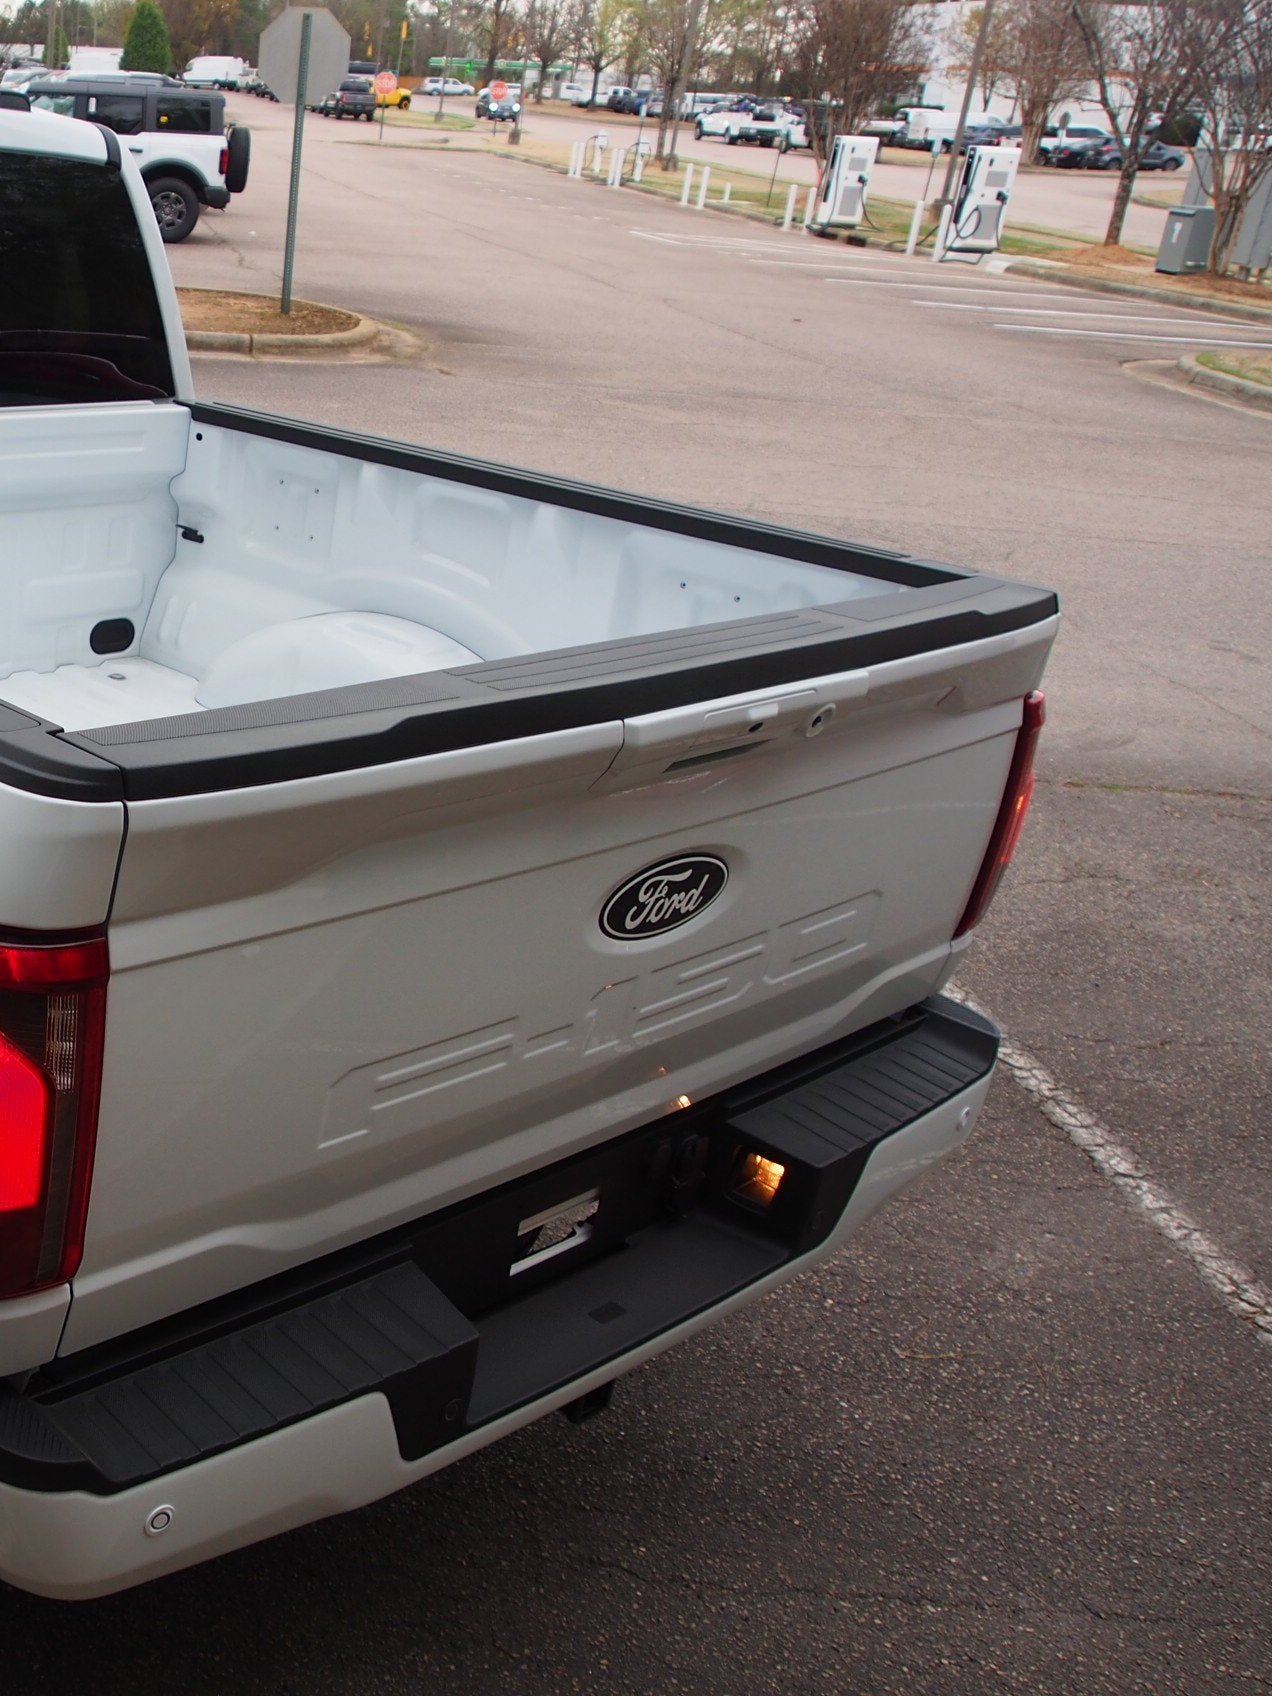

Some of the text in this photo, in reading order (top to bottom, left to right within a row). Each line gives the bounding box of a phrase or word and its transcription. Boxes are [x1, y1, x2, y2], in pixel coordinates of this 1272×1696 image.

[377, 79, 396, 88] STOP
[625, 868, 709, 929] Ford
[318, 888, 884, 1150] F-150
